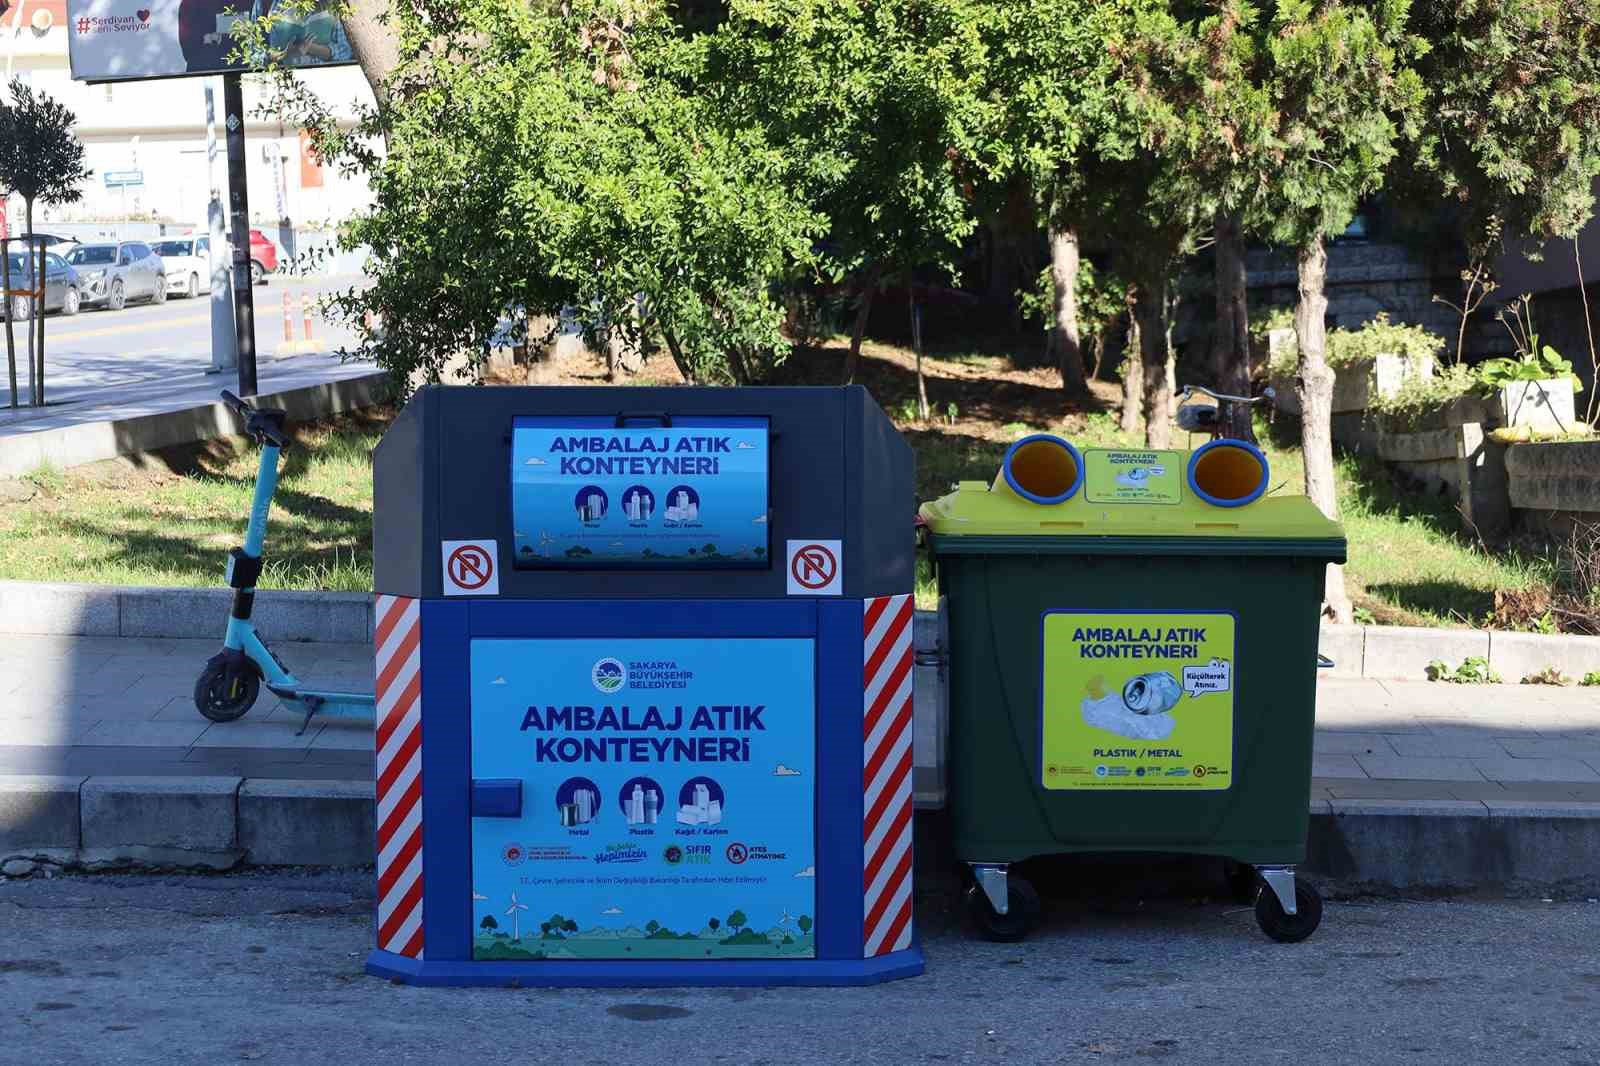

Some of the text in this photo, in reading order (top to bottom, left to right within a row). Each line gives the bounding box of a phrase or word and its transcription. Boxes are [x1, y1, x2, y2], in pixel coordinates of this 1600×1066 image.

[549, 436, 731, 453] AMBALAJ ATIK
[560, 456, 719, 475] KONTEYNERİ
[1072, 628, 1207, 642] AMBALAJ ATIK
[1080, 644, 1198, 658] KONTEYNERİ
[629, 662, 677, 670] SAKARYA
[629, 670, 693, 680] BÜYÜKŞEHİR
[1187, 672, 1225, 680] Küçülterek
[629, 680, 687, 689] BELEDİYESİ
[520, 706, 766, 731] AMBALAJ ATIK
[535, 737, 750, 763] KONTEYNERİ
[1147, 749, 1182, 758] METAL
[593, 847, 648, 863] Hepimizin
[685, 845, 712, 855] SIFIR
[685, 855, 711, 864] ATIK
